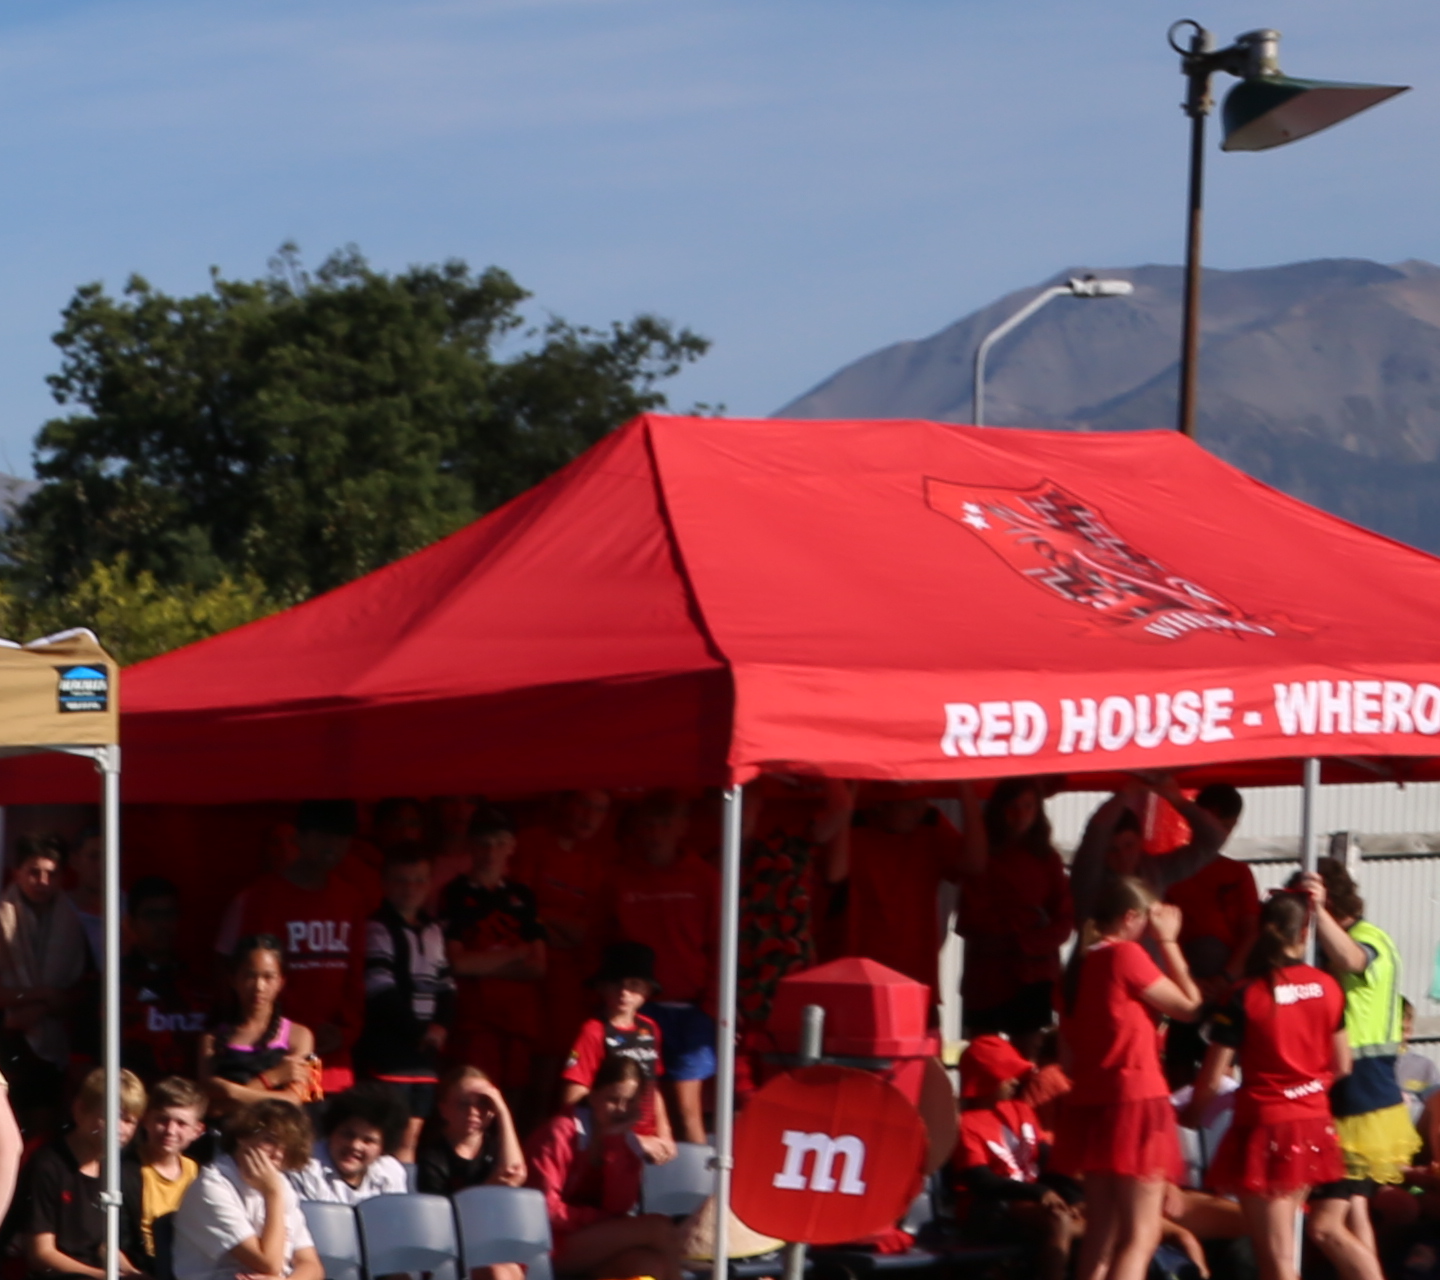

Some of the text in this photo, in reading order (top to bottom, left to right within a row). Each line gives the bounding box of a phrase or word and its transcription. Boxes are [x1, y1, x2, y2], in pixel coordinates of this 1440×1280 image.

[940, 700, 1049, 757] RED
[1058, 687, 1235, 753] HOUSE
[1273, 679, 1440, 736] WHERO
[147, 1005, 207, 1031] bnz
[772, 1130, 867, 1196] m
